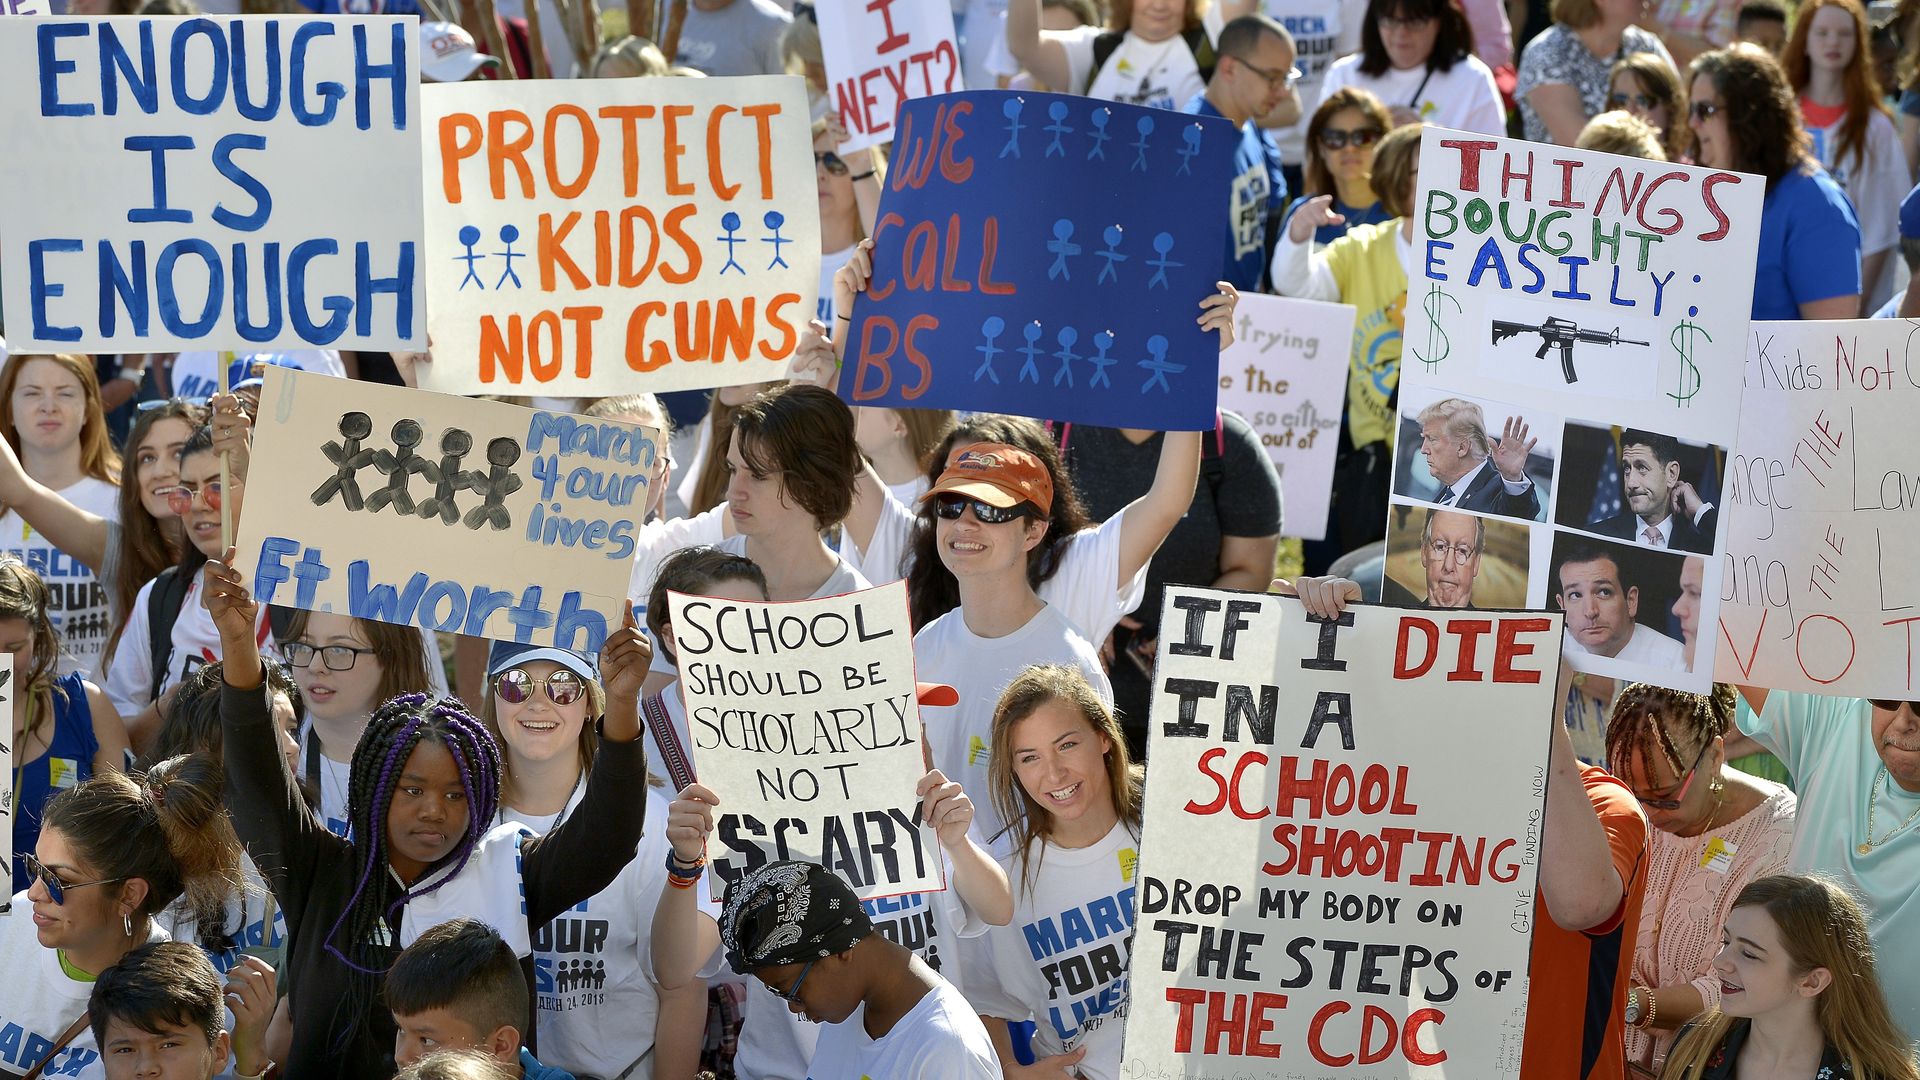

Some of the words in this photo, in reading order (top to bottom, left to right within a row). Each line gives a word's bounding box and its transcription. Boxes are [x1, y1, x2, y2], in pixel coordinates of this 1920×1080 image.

[867, 0, 909, 55] I
[37, 19, 406, 131] ENOUGH
[836, 40, 957, 135] NEXT?
[124, 133, 273, 232] IS
[439, 104, 781, 204] PROTECT
[893, 101, 974, 192] WE
[1440, 140, 1742, 243] THINGS
[538, 203, 702, 291] KIDS
[1425, 190, 1664, 273] BOUGHT
[29, 238, 415, 346] ENOUGH
[1426, 238, 1702, 318] EASILY:
[479, 306, 603, 384] NOT
[625, 293, 802, 373] GUNS
[853, 315, 939, 402] BS
[1239, 314, 1320, 360] trying
[1755, 330, 1822, 391] Kids
[1836, 334, 1895, 391] Not
[526, 410, 656, 468] March
[1254, 411, 1278, 427] so
[1262, 429, 1294, 448] out
[1298, 428, 1319, 449] of
[1791, 409, 1844, 489] THE
[526, 502, 635, 560] lives
[1809, 524, 1845, 600] THE
[347, 559, 609, 654] Worth
[678, 602, 894, 655] SCHOOL
[1168, 595, 1262, 661] IF
[1300, 611, 1357, 672] I
[1393, 616, 1552, 684] DIE
[688, 662, 822, 697] SHOULD
[842, 661, 887, 690] BE
[1163, 677, 1280, 745] IN
[1300, 691, 1356, 750] A
[694, 693, 916, 756] SCHOLARLY
[757, 762, 859, 802] NOT
[1183, 747, 1420, 820] SCHOOL
[712, 800, 925, 888] SCARY
[1261, 822, 1521, 887] SHOOTING
[1510, 888, 1532, 934] GIVE
[1521, 808, 1541, 866] FUNDING
[1532, 765, 1544, 798] NOW
[533, 918, 610, 954] OUR
[1141, 876, 1241, 917] DROP
[1258, 887, 1310, 920] MY
[1322, 893, 1401, 925] BODY
[1417, 900, 1463, 928] ON
[581, 992, 605, 1006] 2018
[1040, 943, 1123, 1001] FOR
[1153, 919, 1265, 982] THE
[1280, 936, 1460, 1002] STEPS
[1474, 969, 1512, 993] OF
[1166, 986, 1289, 1059] THE
[1306, 1000, 1449, 1067] CDC
